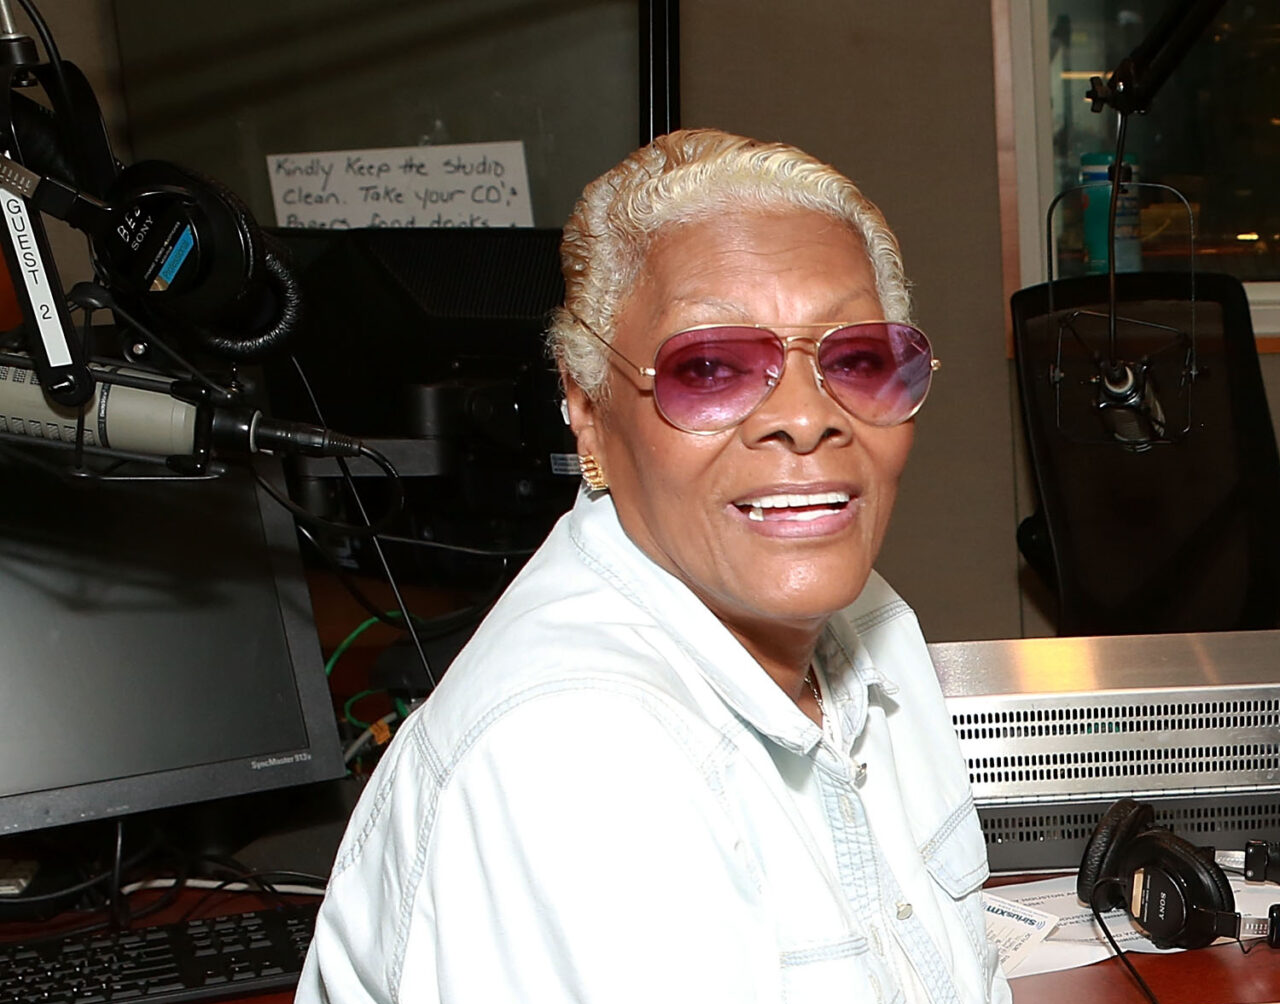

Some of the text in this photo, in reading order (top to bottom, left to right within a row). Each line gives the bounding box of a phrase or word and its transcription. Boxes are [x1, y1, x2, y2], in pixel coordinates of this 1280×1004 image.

[275, 157, 333, 191] Kindly
[345, 157, 391, 178] Keep
[401, 155, 428, 176] the
[359, 185, 404, 204] Take
[414, 188, 466, 209] your
[131, 215, 154, 251] SONY
[6, 199, 52, 320] GUEST 2
[1159, 891, 1168, 920] SONY
